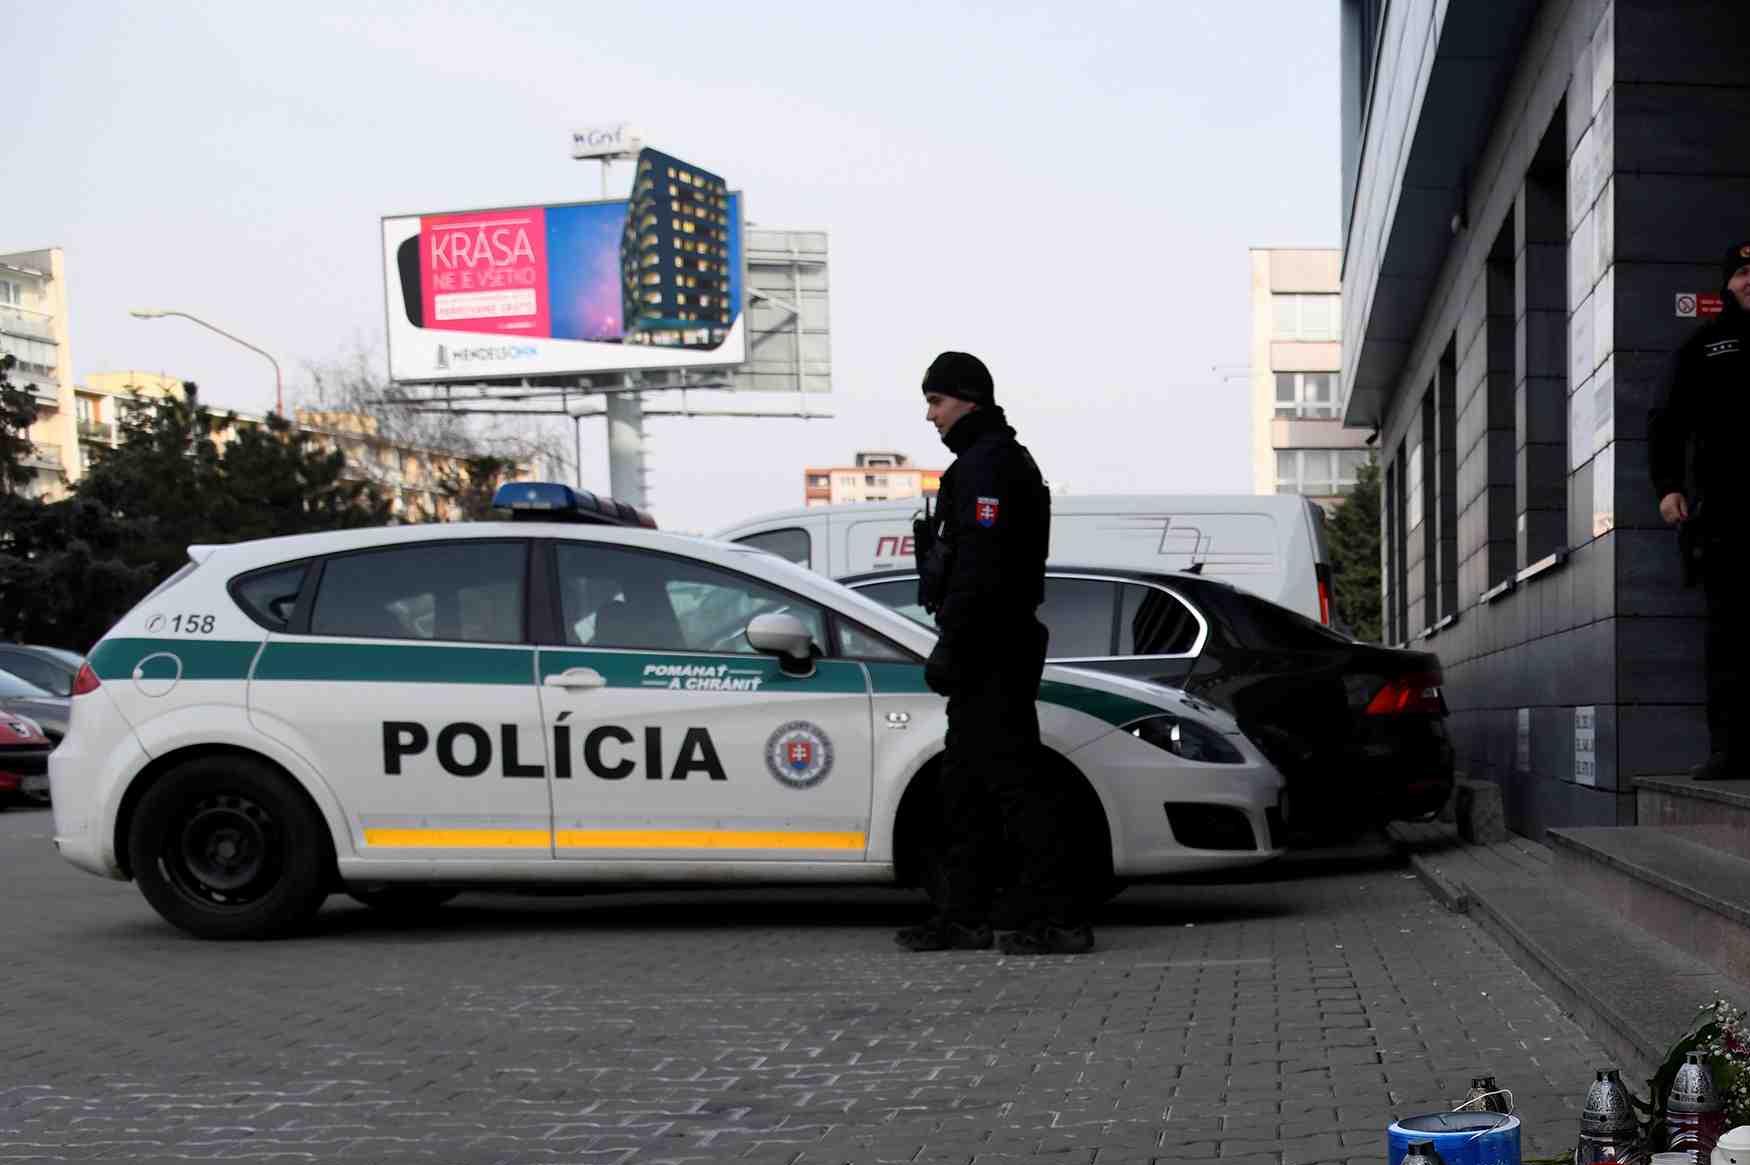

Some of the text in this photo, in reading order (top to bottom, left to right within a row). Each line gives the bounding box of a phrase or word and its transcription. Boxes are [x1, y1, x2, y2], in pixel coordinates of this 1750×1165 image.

[431, 222, 536, 270] KRÁSA
[171, 614, 216, 634] 158
[668, 676, 763, 692] A CHRÁNIŤ
[382, 710, 728, 781] POLÍCIA
